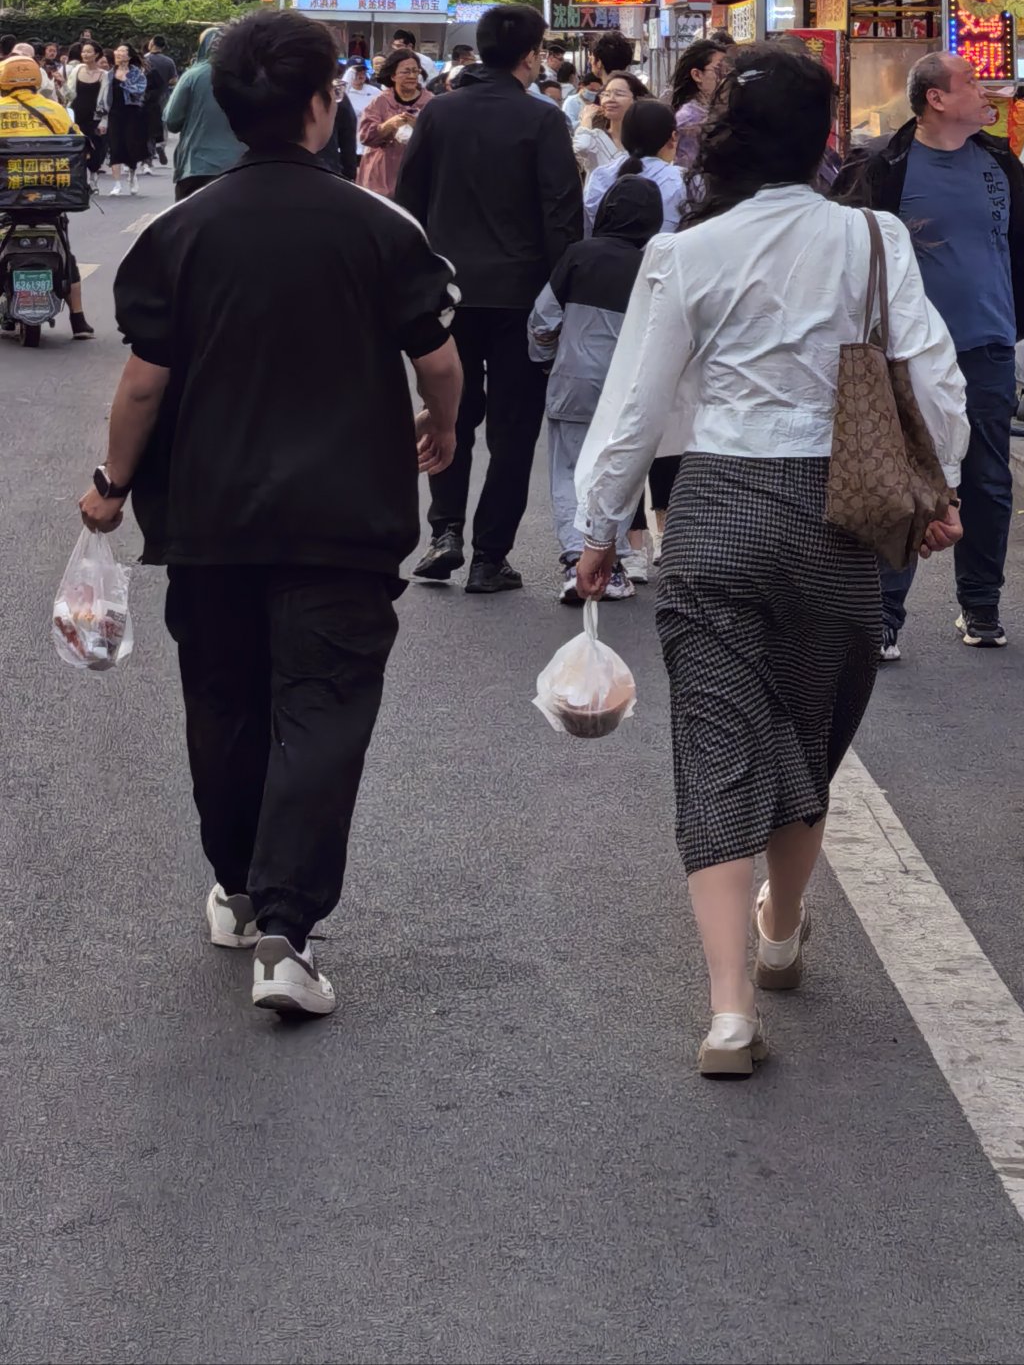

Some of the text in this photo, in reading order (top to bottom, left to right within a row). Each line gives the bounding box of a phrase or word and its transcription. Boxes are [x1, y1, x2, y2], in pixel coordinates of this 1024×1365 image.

[7, 157, 70, 173] 美团配送
[7, 173, 71, 190] 准时好用
